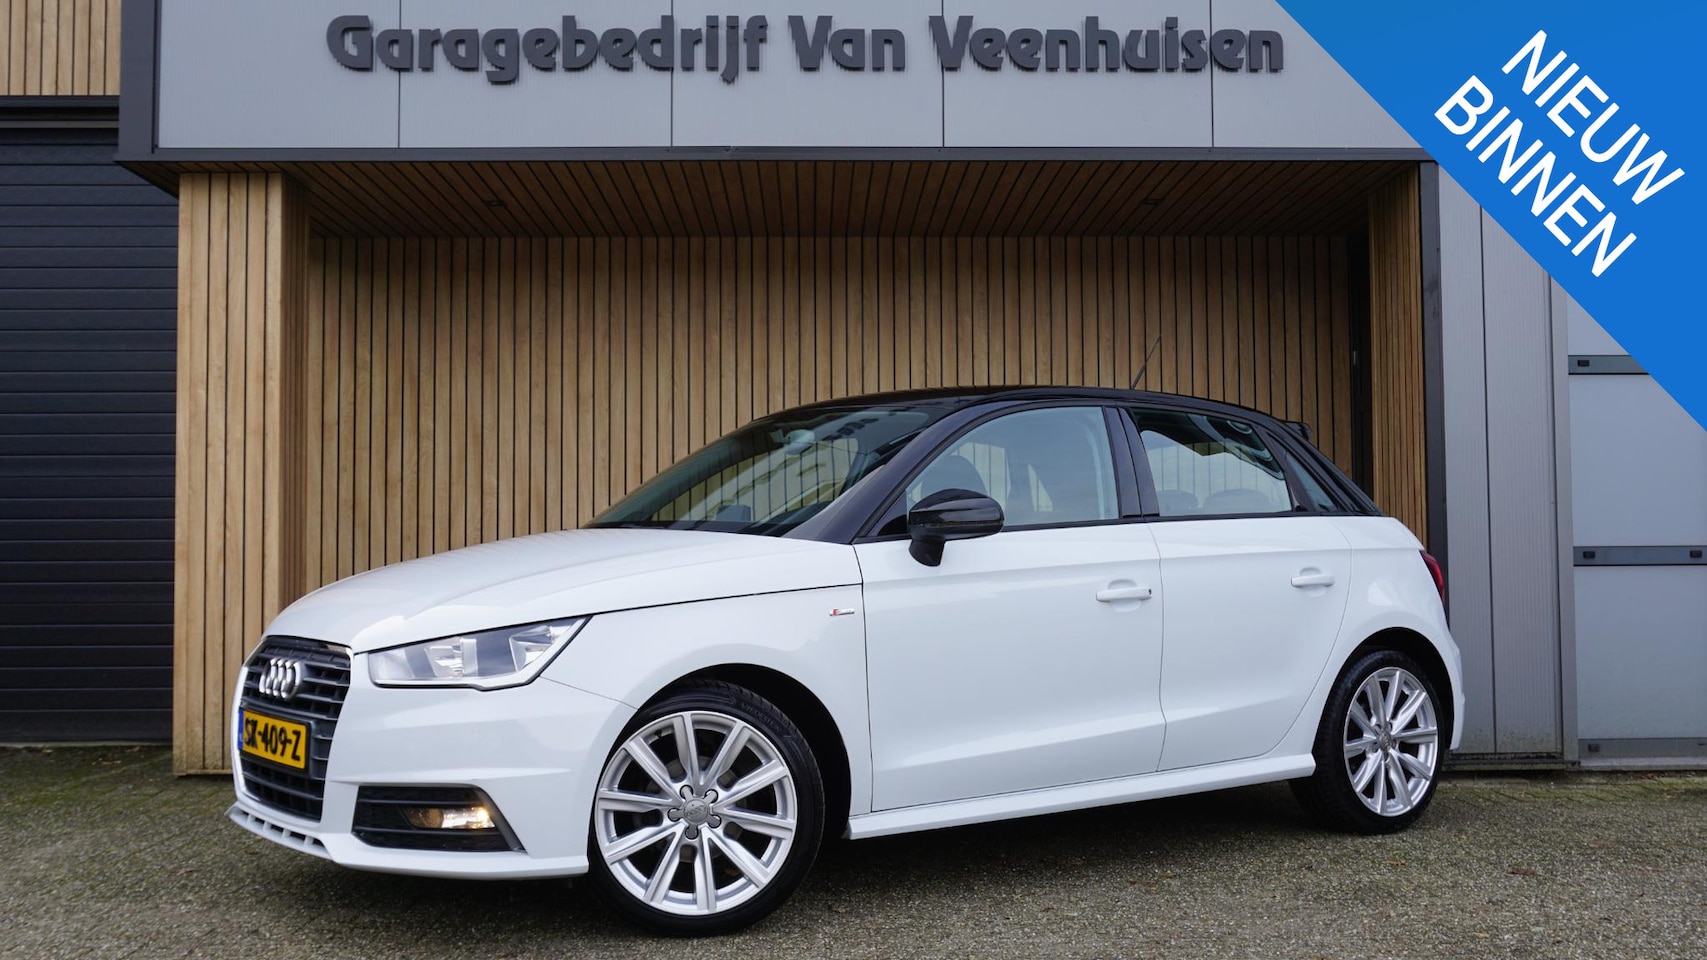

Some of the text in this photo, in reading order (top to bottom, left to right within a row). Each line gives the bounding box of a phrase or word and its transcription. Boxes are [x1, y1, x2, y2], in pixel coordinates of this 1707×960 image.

[326, 15, 1284, 84] Garagebedrijf Van Veenhuisen
